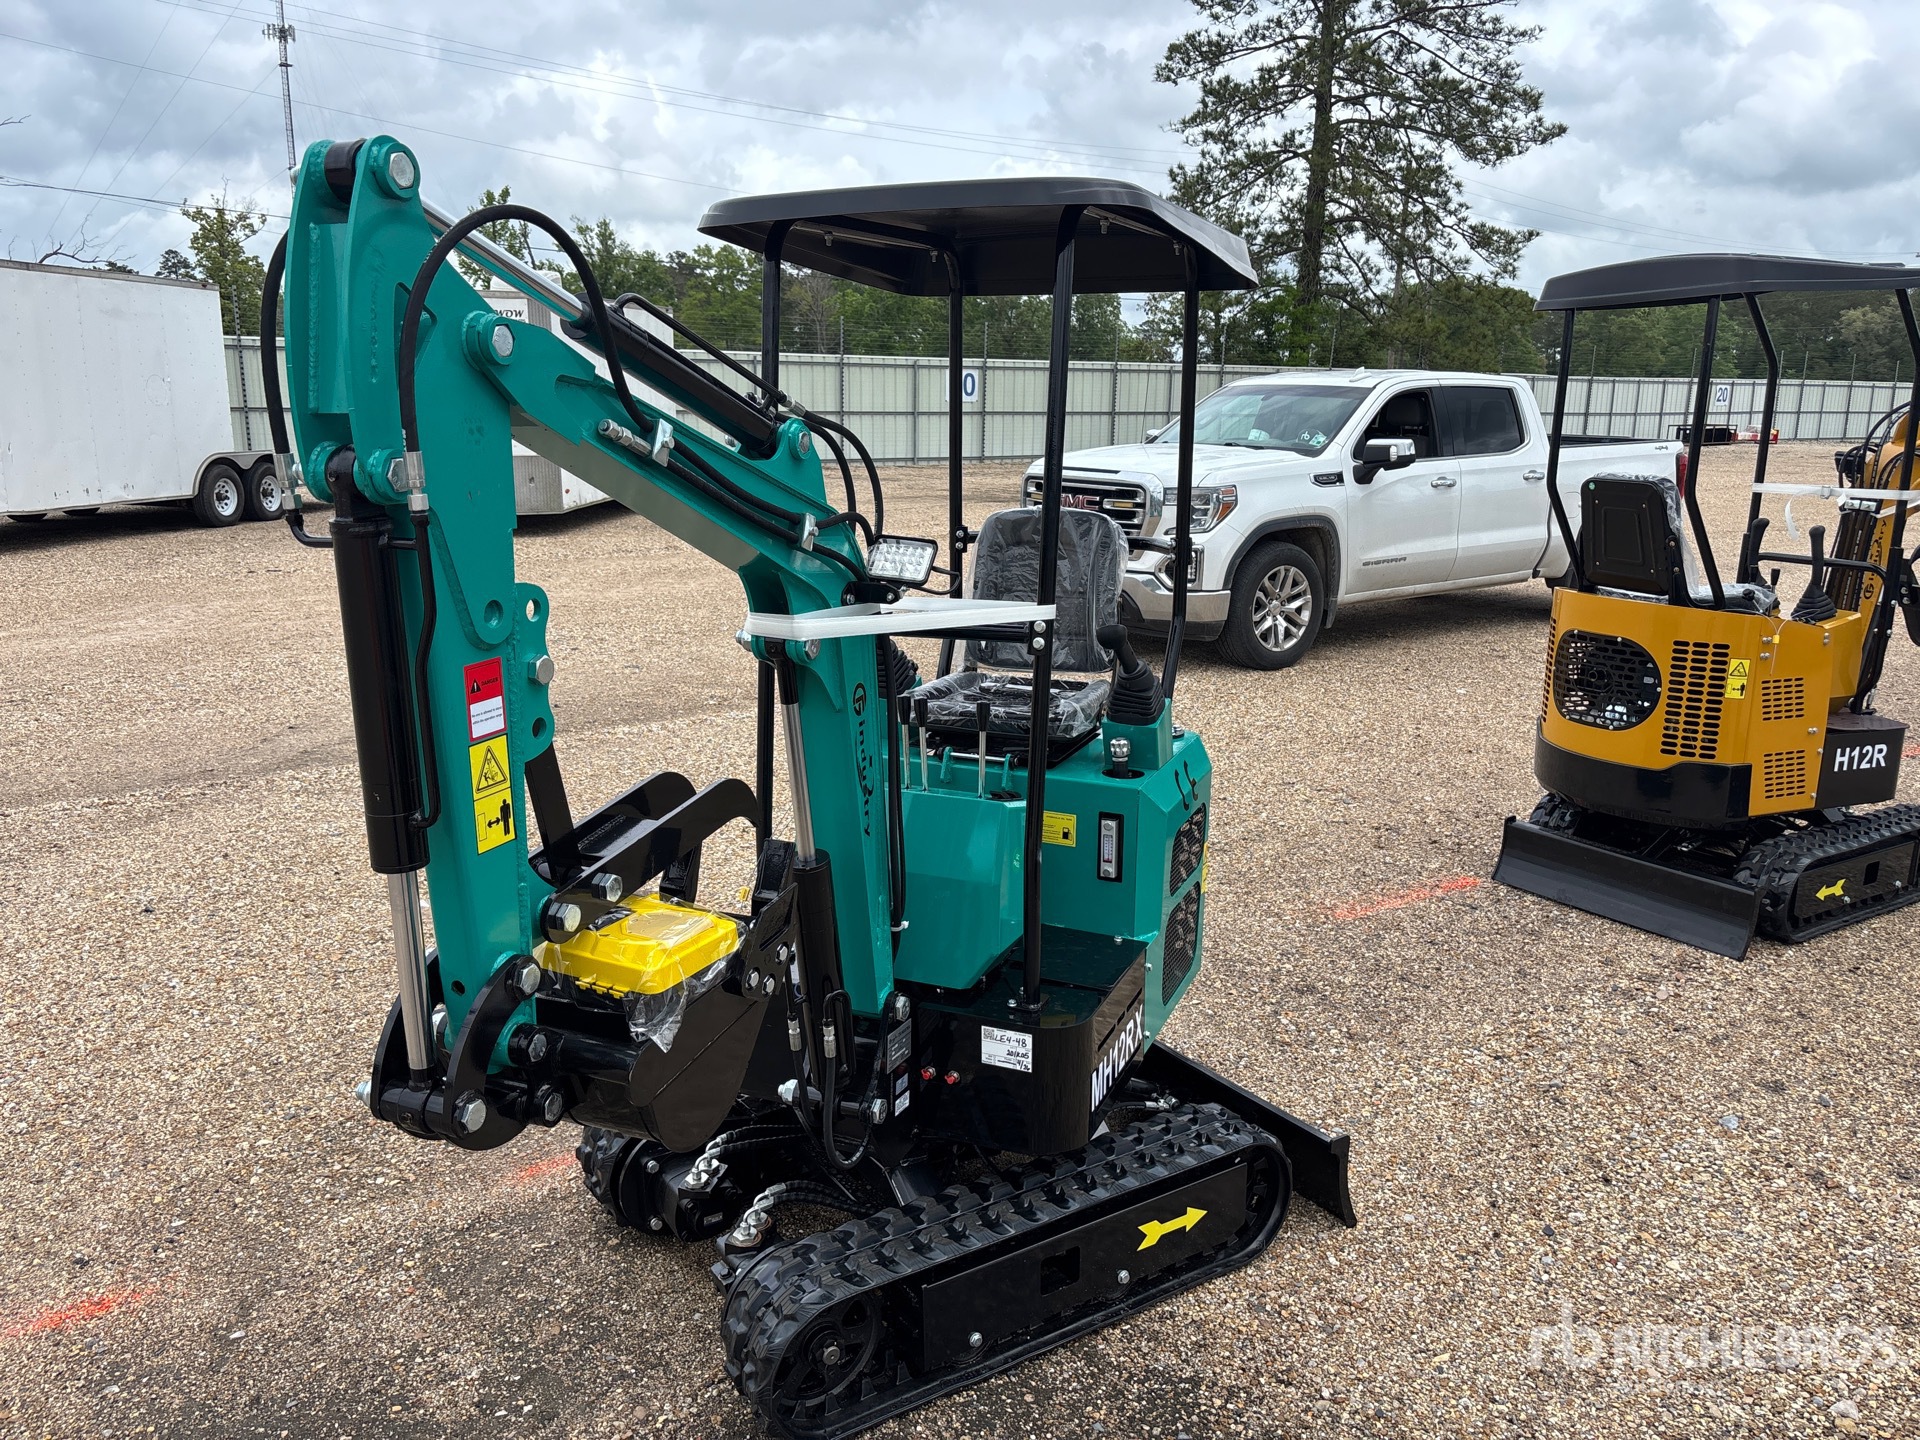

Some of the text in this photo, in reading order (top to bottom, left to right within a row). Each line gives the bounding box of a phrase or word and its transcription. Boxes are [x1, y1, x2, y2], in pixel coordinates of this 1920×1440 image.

[1716, 386, 1729, 402] 20
[1060, 493, 1100, 511] MC
[1833, 743, 1888, 772] H12R
[995, 1034, 1028, 1048] LE4-48
[1091, 1003, 1143, 1113] MH12RX
